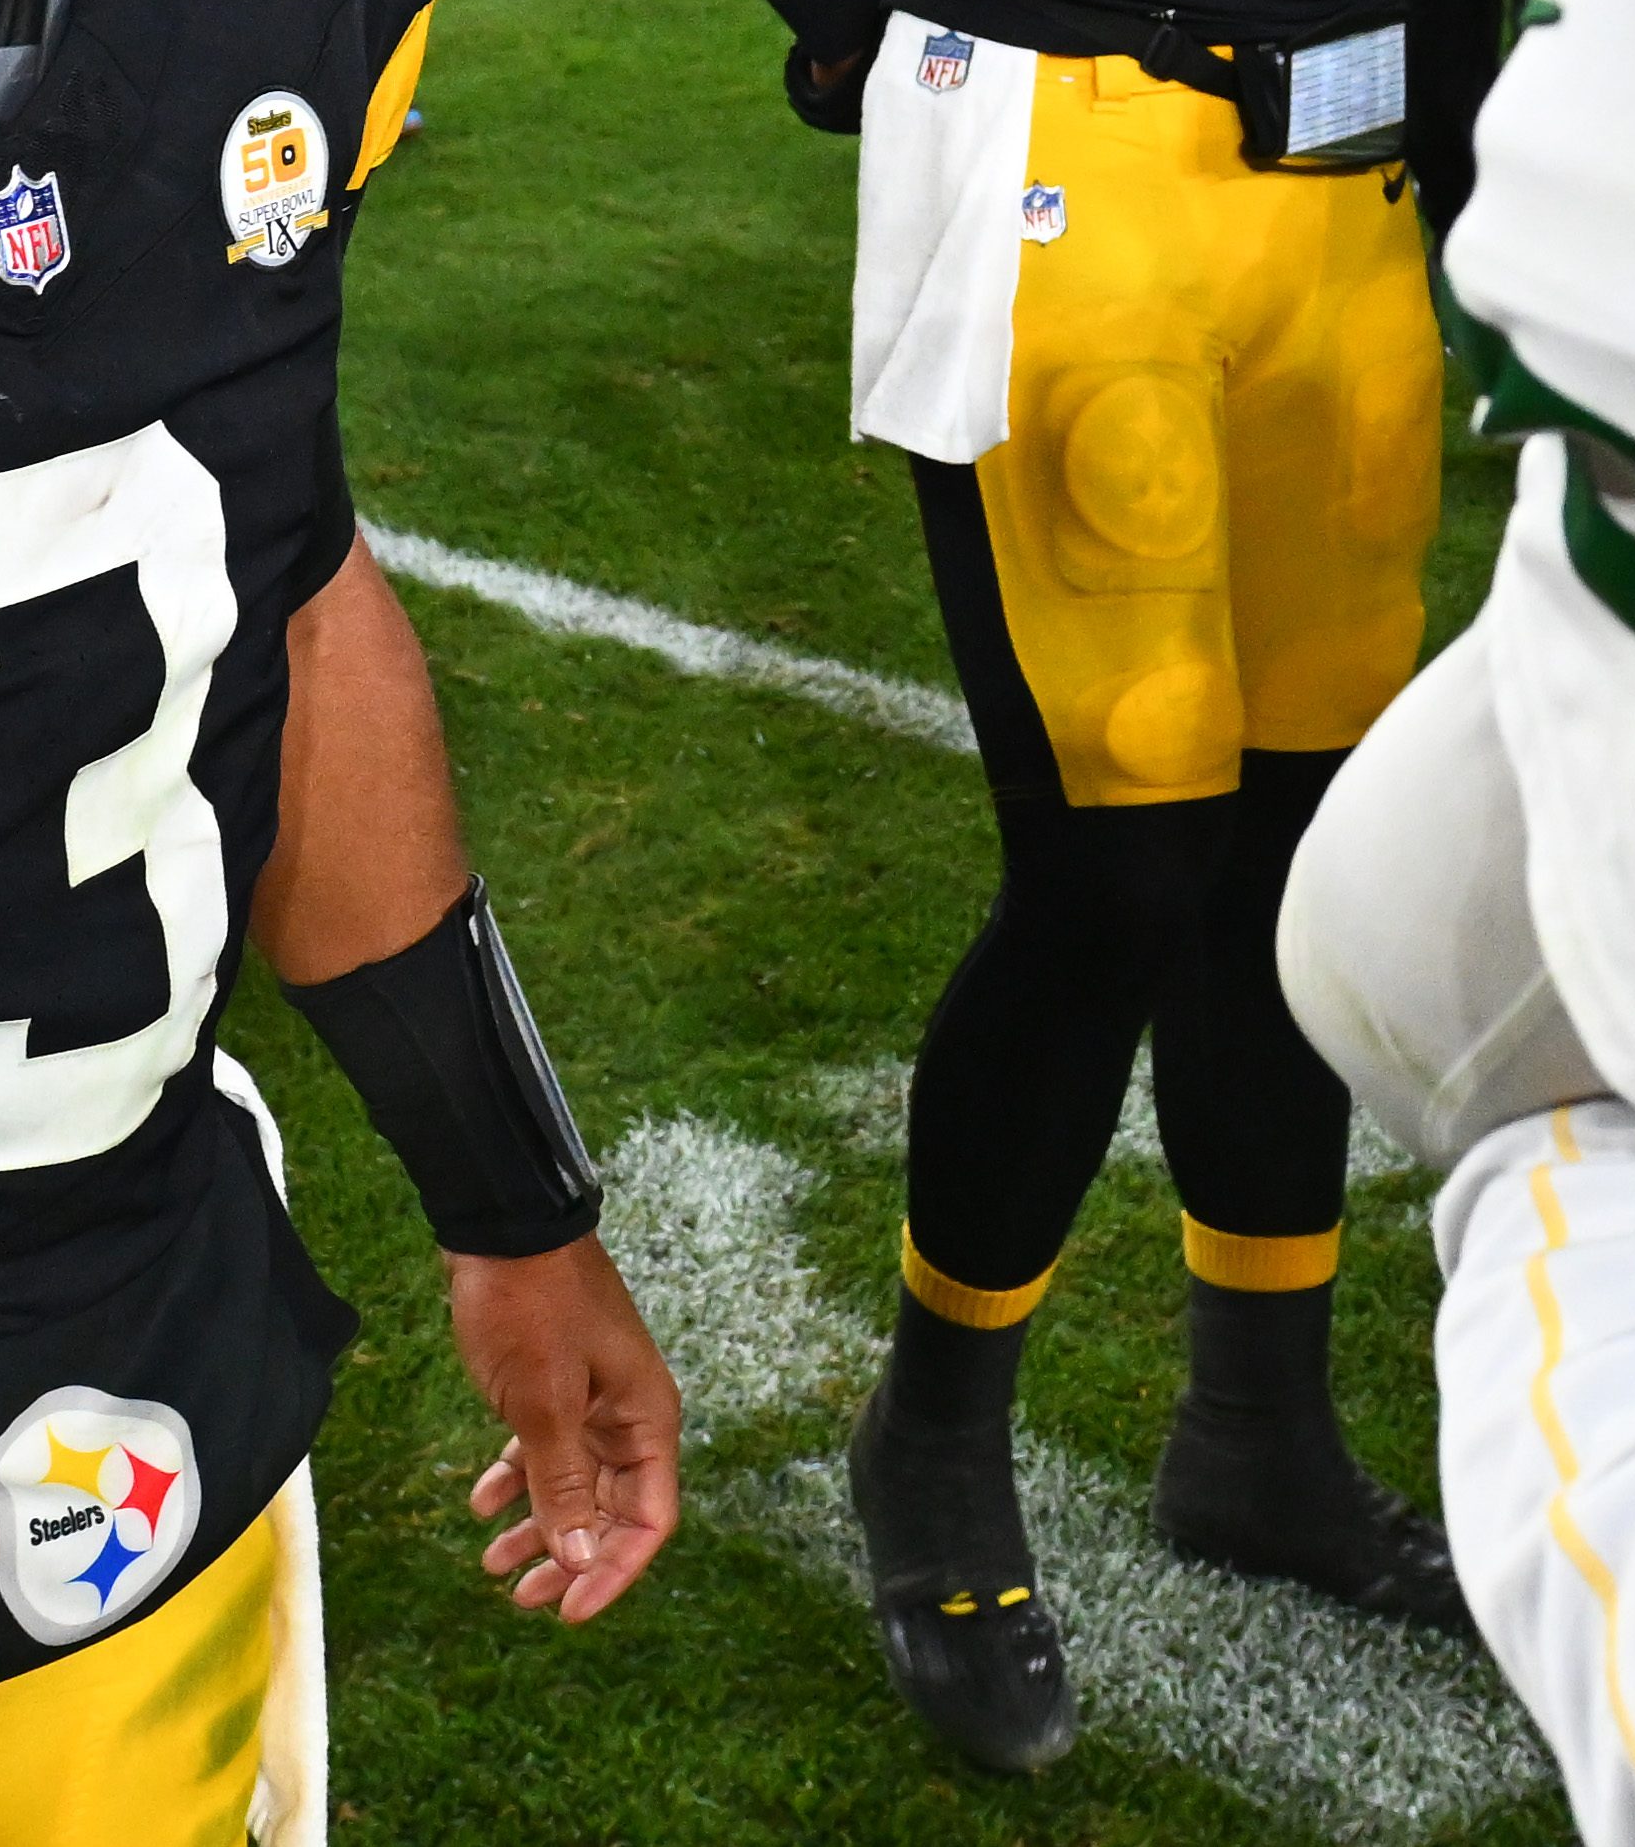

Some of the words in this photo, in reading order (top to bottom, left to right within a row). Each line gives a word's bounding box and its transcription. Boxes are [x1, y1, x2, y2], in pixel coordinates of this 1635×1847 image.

[923, 56, 963, 89] NFL
[241, 127, 307, 194] 50
[237, 202, 280, 232] SUPER
[281, 189, 317, 215] BOWL
[1024, 207, 1058, 233] NFL
[6, 221, 62, 271] NFL
[265, 213, 299, 257] IX
[29, 1505, 105, 1546] Steelers
